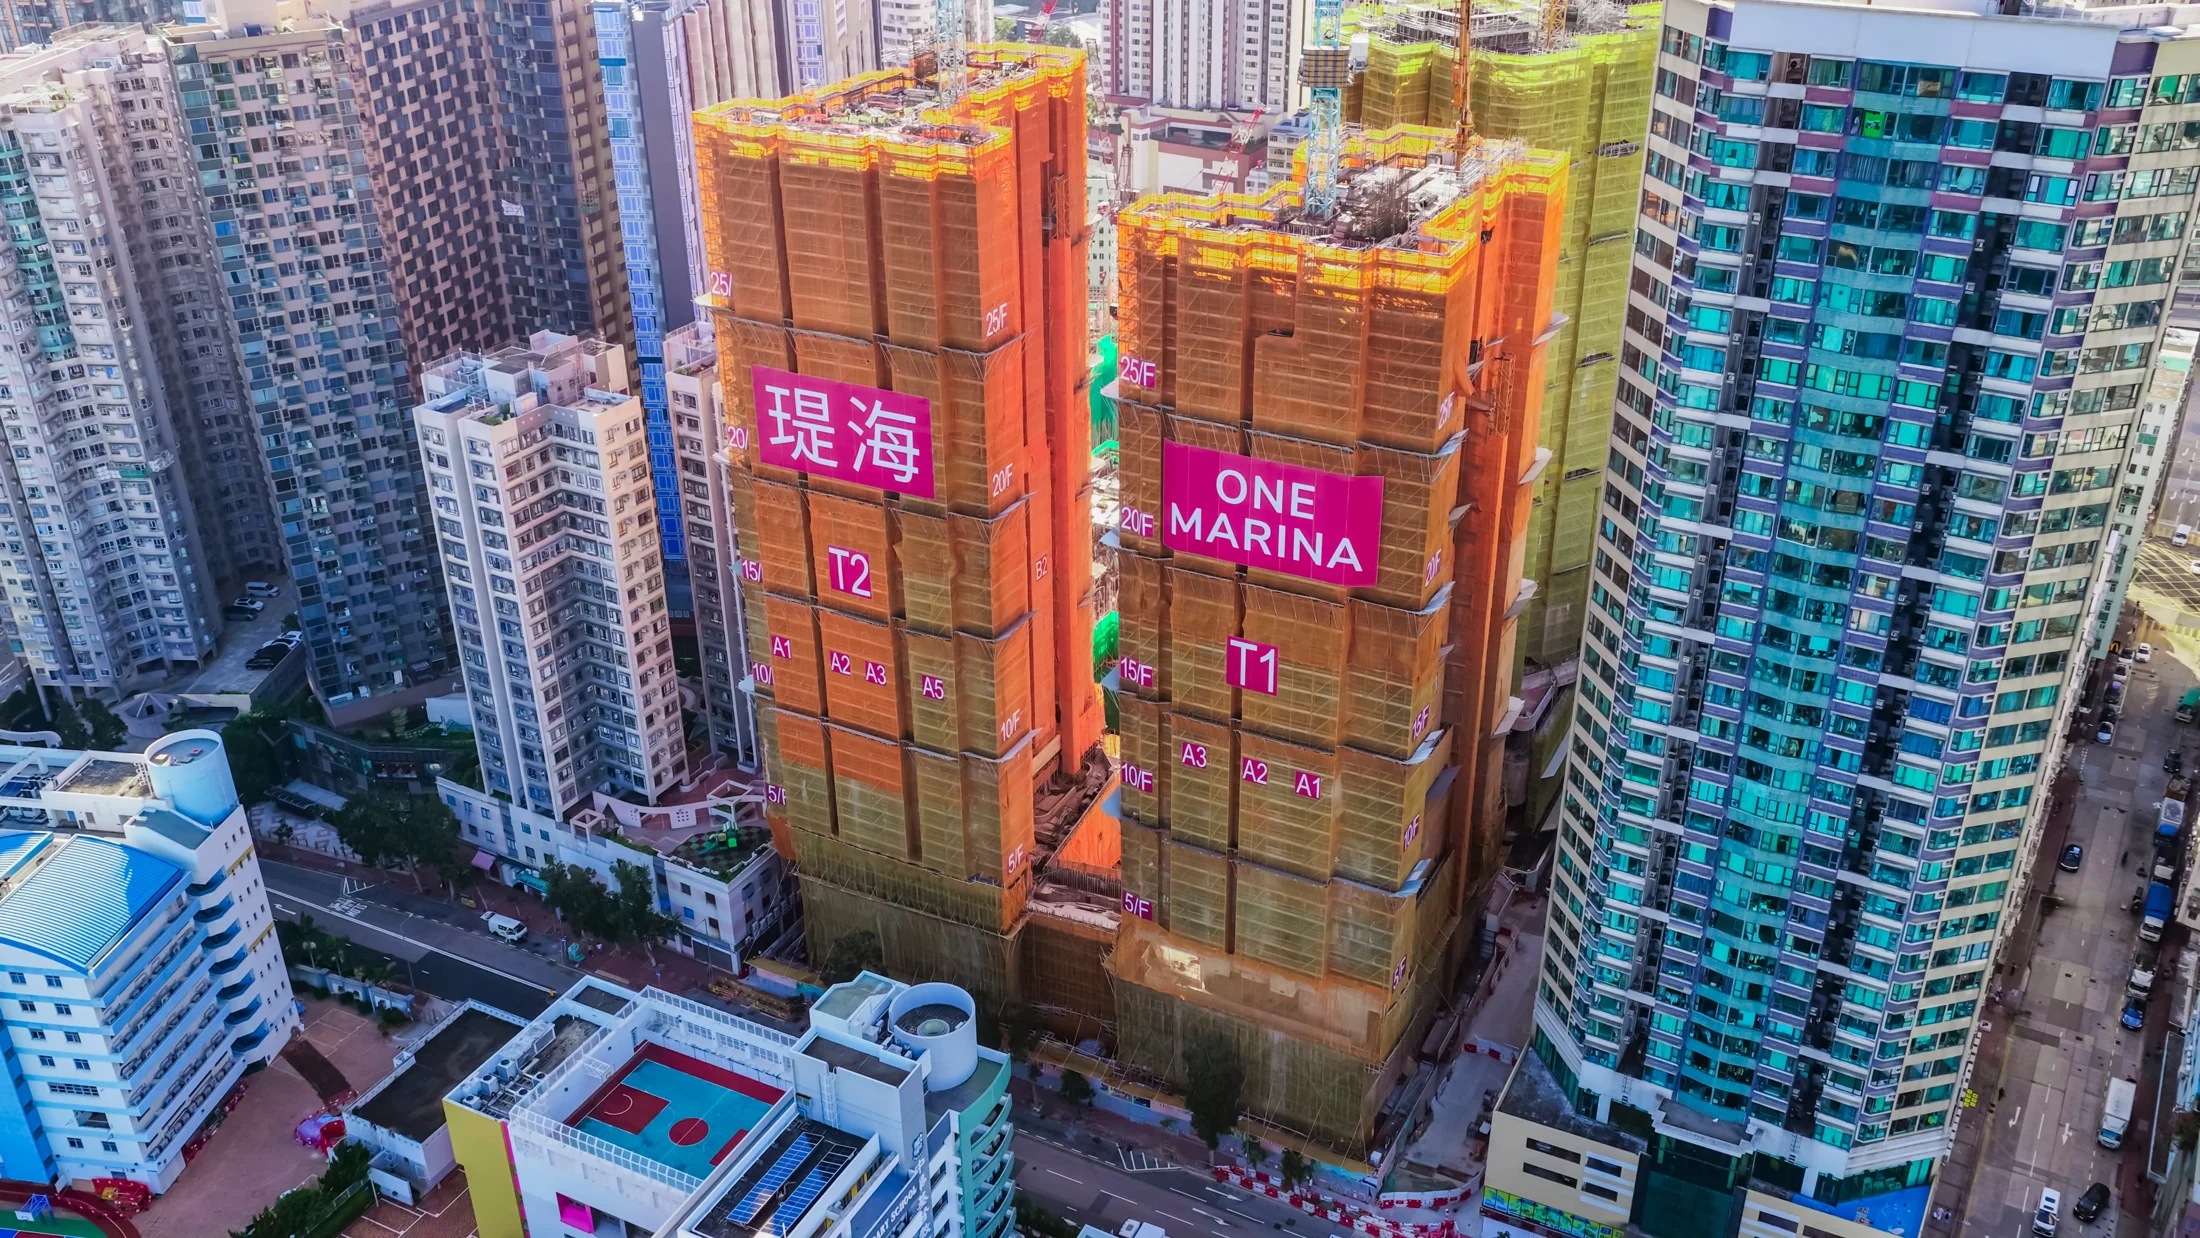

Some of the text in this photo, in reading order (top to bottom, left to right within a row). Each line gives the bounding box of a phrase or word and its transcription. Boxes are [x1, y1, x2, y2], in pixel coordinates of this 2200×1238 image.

[711, 271, 732, 297] 25/
[986, 302, 1008, 338] 25/F
[1120, 356, 1155, 387] 25/F
[728, 426, 748, 450] 20/
[765, 385, 920, 483] 瑅海
[993, 463, 1013, 497] 20/F
[1216, 470, 1316, 520] ONE
[1121, 507, 1153, 537] 20/F
[1171, 502, 1363, 572] MARINA
[742, 559, 763, 582] 15/
[828, 546, 872, 597] T2
[1035, 556, 1048, 580] B2
[772, 638, 792, 660] A1
[752, 662, 775, 685] 10/
[830, 652, 851, 675] A2
[865, 662, 887, 686] A3
[1120, 657, 1152, 687] 15/F
[1230, 640, 1276, 693] T1
[922, 676, 944, 700] A5
[1001, 708, 1020, 742] 10/F
[1182, 743, 1207, 768] A3
[1121, 763, 1152, 792] 10/F
[1243, 759, 1268, 785] A2
[1295, 773, 1321, 798] A1
[768, 784, 787, 806] 5/F
[1008, 843, 1023, 874] 5/F
[1125, 892, 1151, 919] 5/F
[891, 1185, 917, 1222] SCHOOL
